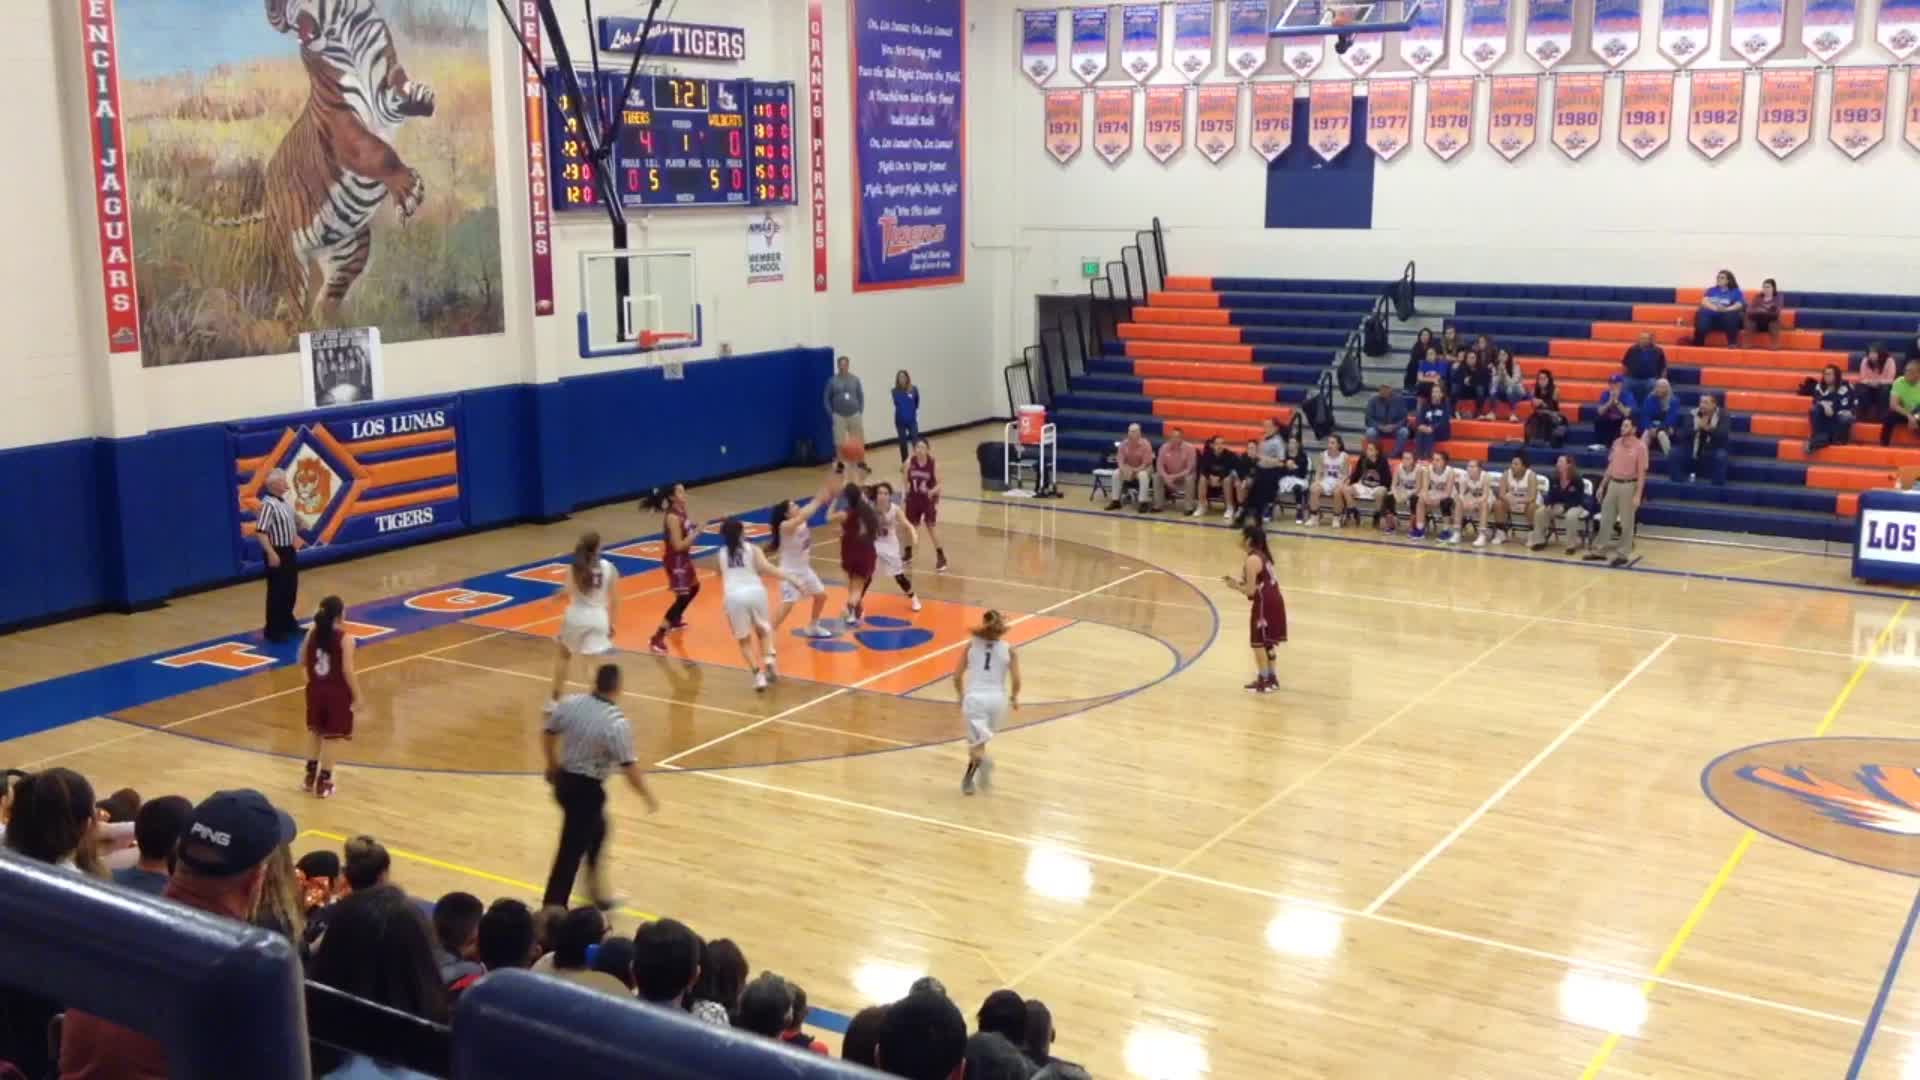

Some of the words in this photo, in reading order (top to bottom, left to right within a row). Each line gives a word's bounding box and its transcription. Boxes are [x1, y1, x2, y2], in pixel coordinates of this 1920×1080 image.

[670, 26, 744, 58] TIGERS
[811, 21, 823, 118] GRANTS
[1369, 115, 1408, 129] 1977
[1430, 115, 1469, 129] 1978
[1493, 113, 1534, 128] 1979
[1557, 112, 1598, 126] 1980
[1625, 110, 1666, 125] 1981
[1692, 110, 1738, 124] 1982
[1762, 109, 1808, 124] 1983
[1834, 108, 1881, 123] 1983
[1049, 122, 1078, 134] 1971
[1097, 121, 1128, 133] 1974
[1149, 119, 1181, 132] 1975
[1200, 119, 1233, 132] 1975
[1255, 118, 1289, 131] 1976
[1313, 117, 1349, 130] 1977
[640, 131, 652, 153] 4
[683, 134, 688, 151] 1
[729, 131, 741, 156] 0
[649, 168, 660, 190] 5
[710, 168, 720, 189] 5
[531, 142, 548, 255] EAGLES
[814, 139, 826, 248] PIRATES
[101, 148, 130, 312] JAGUARS
[748, 252, 781, 262] MEMBER
[749, 262, 781, 273] SCHOOL
[352, 419, 385, 439] LOS
[391, 411, 445, 433] LUNAS
[375, 507, 434, 532] TIGERS
[1867, 520, 1917, 552] LOS
[983, 652, 992, 671] 1
[191, 822, 232, 846] PING
